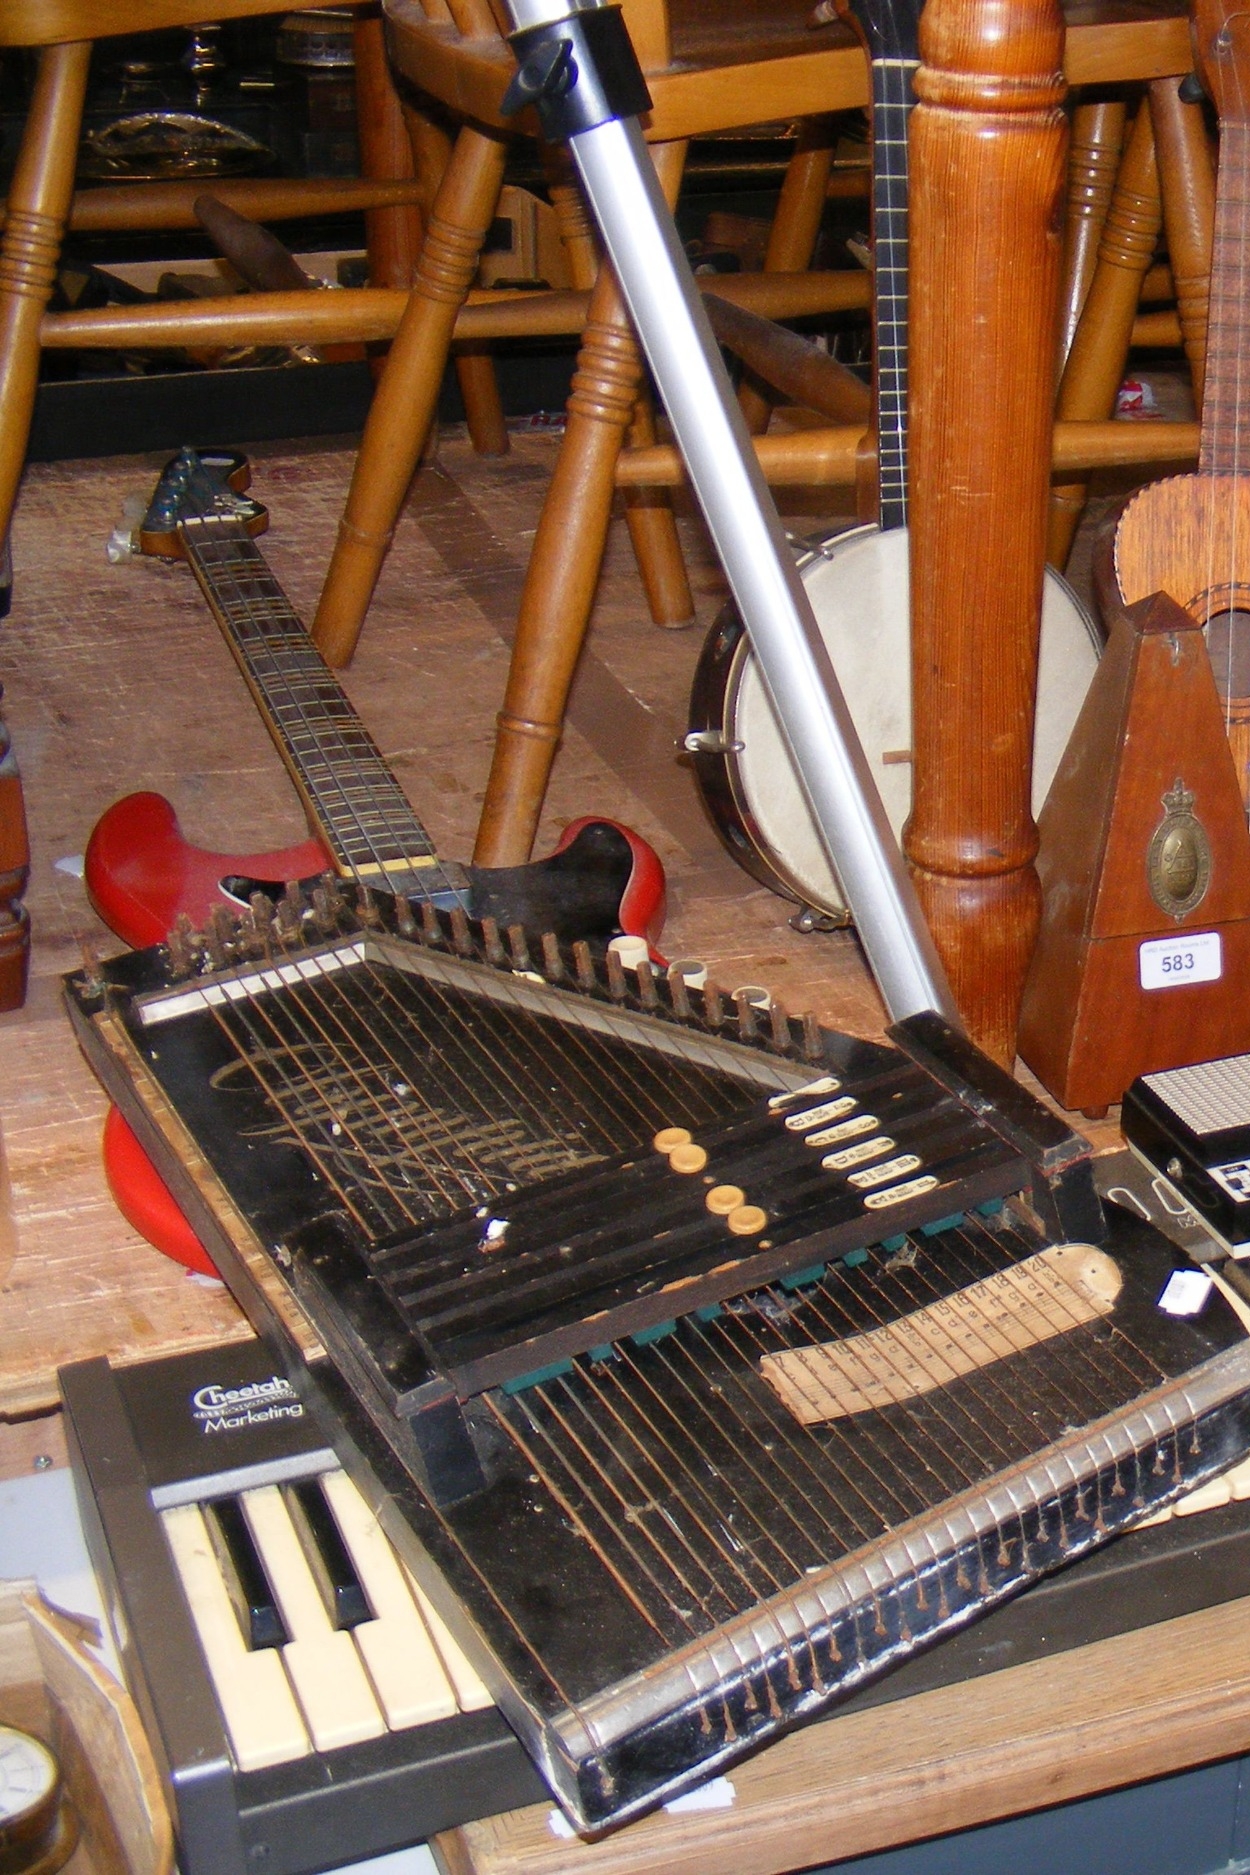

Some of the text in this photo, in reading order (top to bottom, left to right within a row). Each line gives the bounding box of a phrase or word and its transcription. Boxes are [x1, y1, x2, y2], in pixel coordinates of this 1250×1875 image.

[1161, 952, 1195, 973] 583
[192, 1376, 290, 1411] Cheetah
[203, 1403, 304, 1435] Marketing
